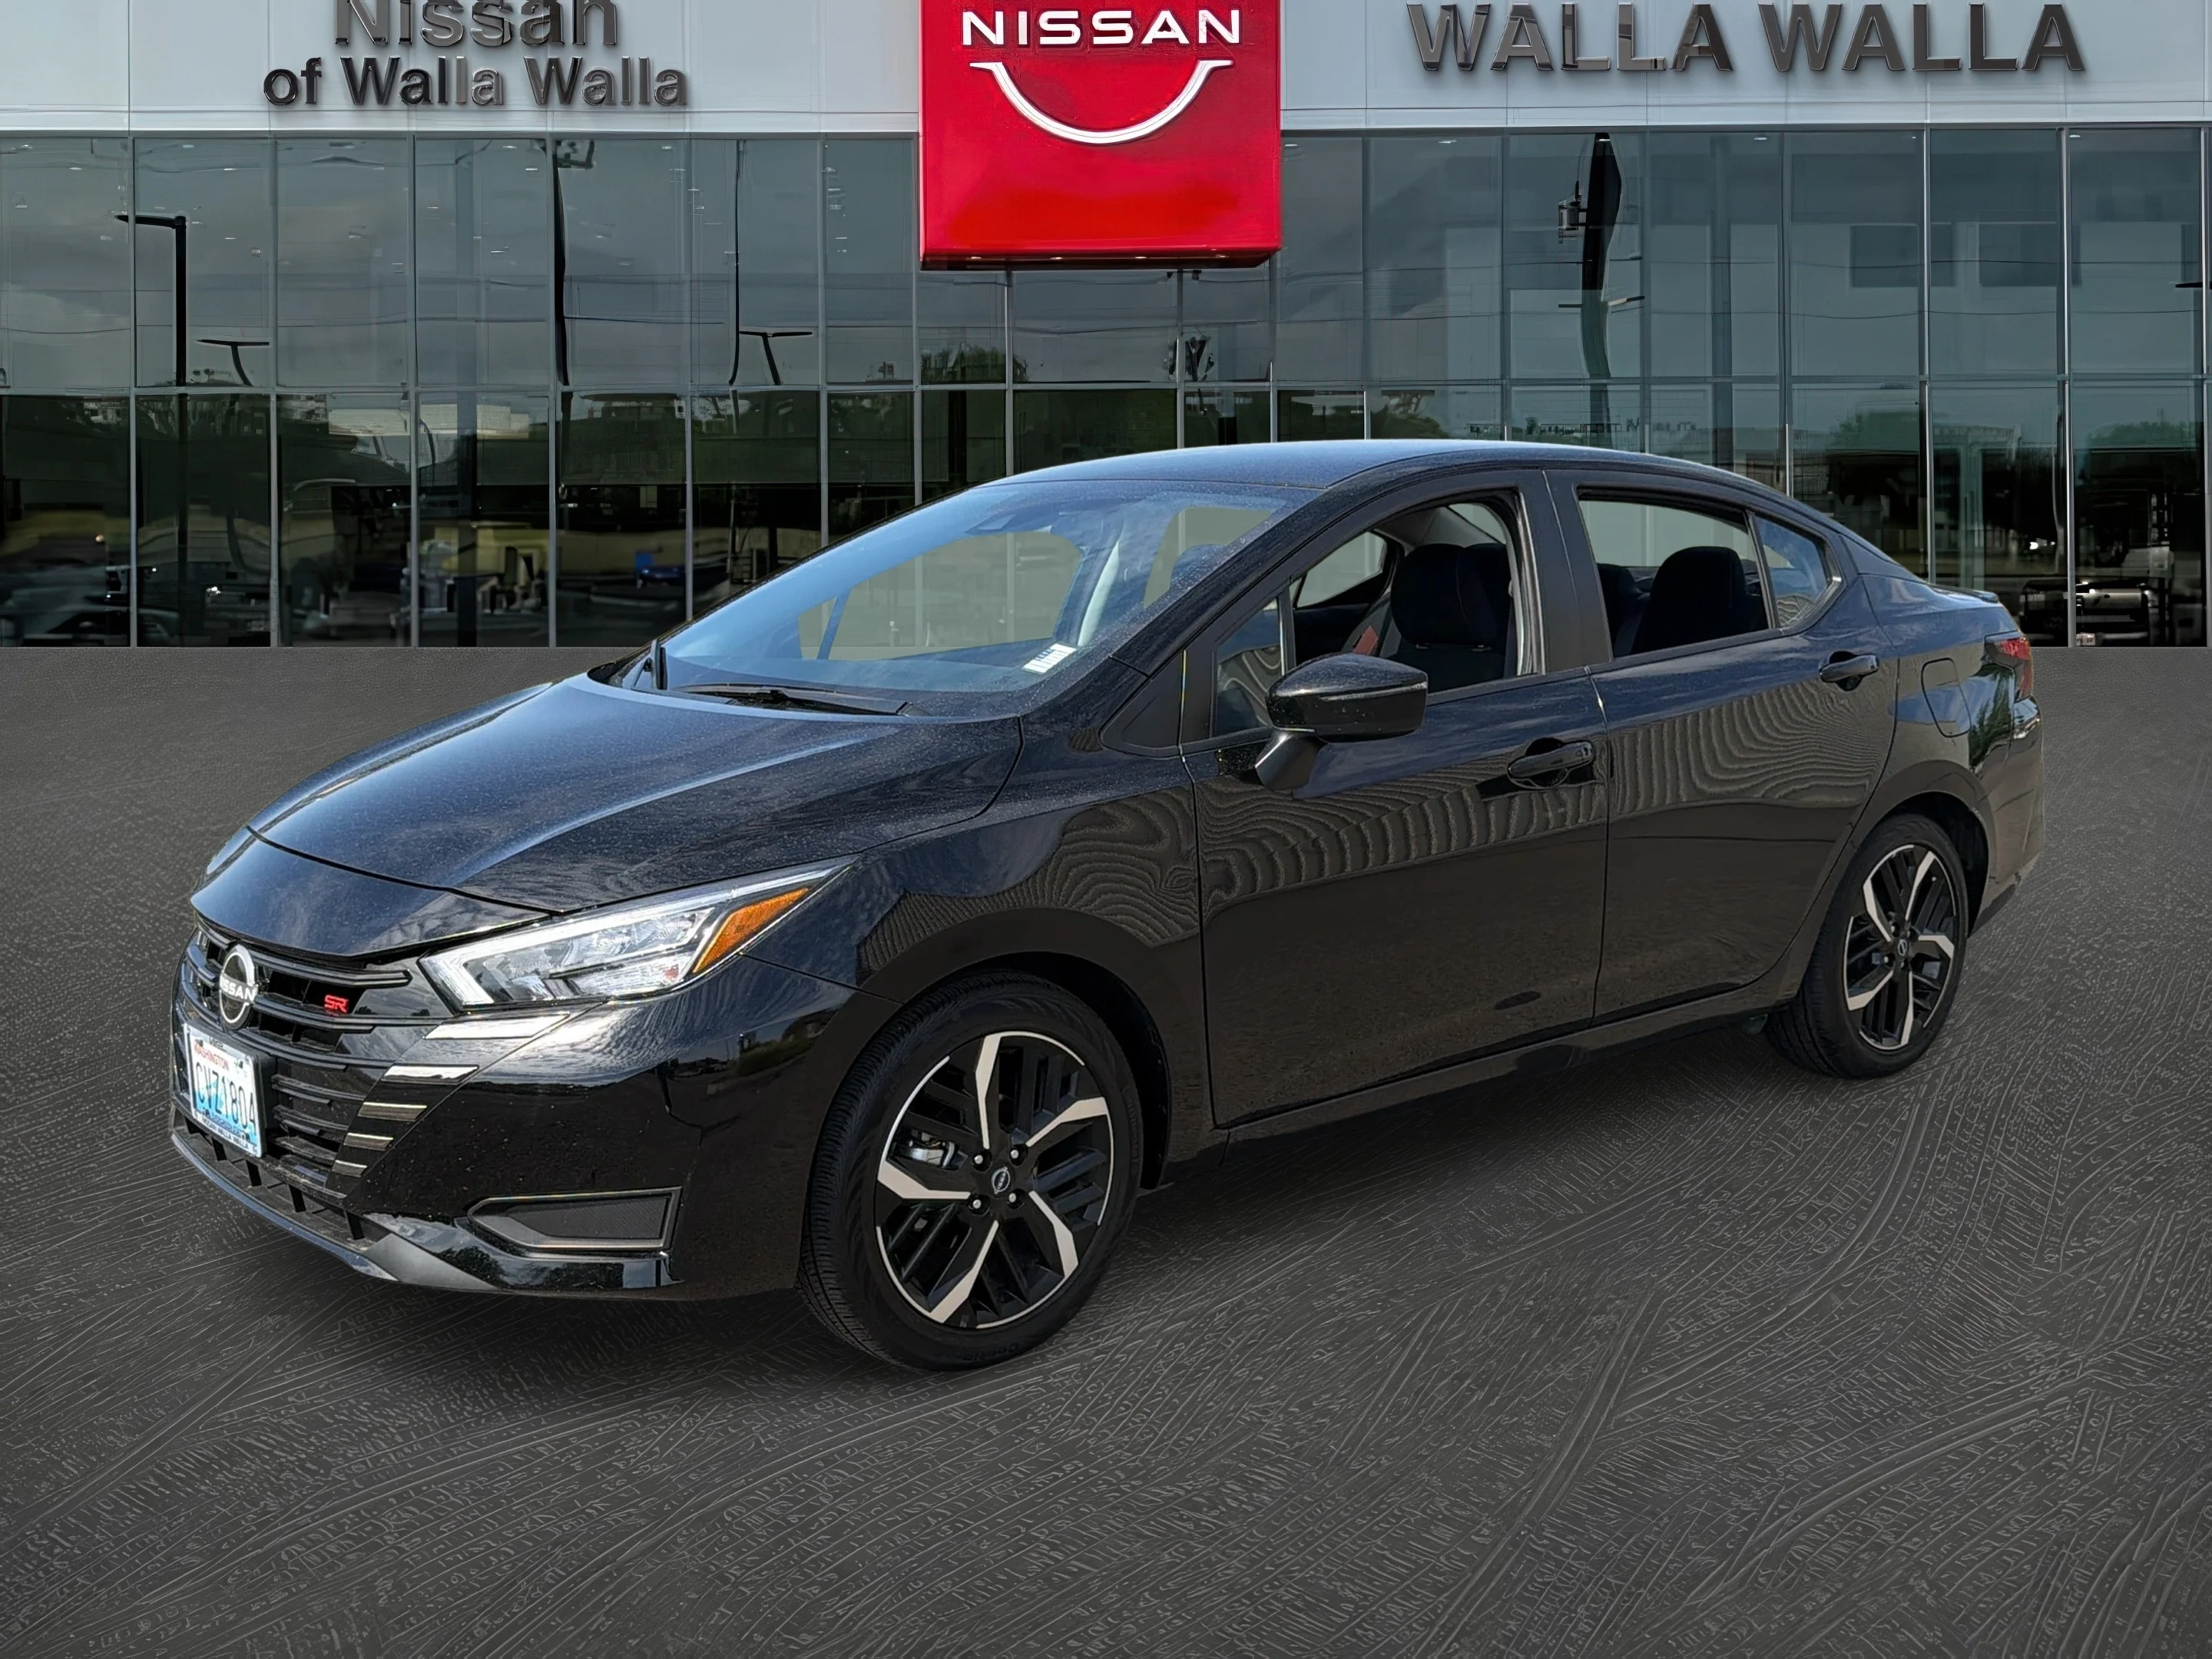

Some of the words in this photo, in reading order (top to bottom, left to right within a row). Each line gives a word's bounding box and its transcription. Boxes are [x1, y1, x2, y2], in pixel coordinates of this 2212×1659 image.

[335, 0, 618, 47] Nissan
[962, 10, 1240, 45] NISSAN
[1406, 2, 1734, 71] WALLA
[1757, 2, 2085, 71] WALLA
[263, 57, 323, 106] of
[339, 56, 504, 106] Walla
[523, 56, 687, 106] Walla
[324, 995, 348, 1013] SR
